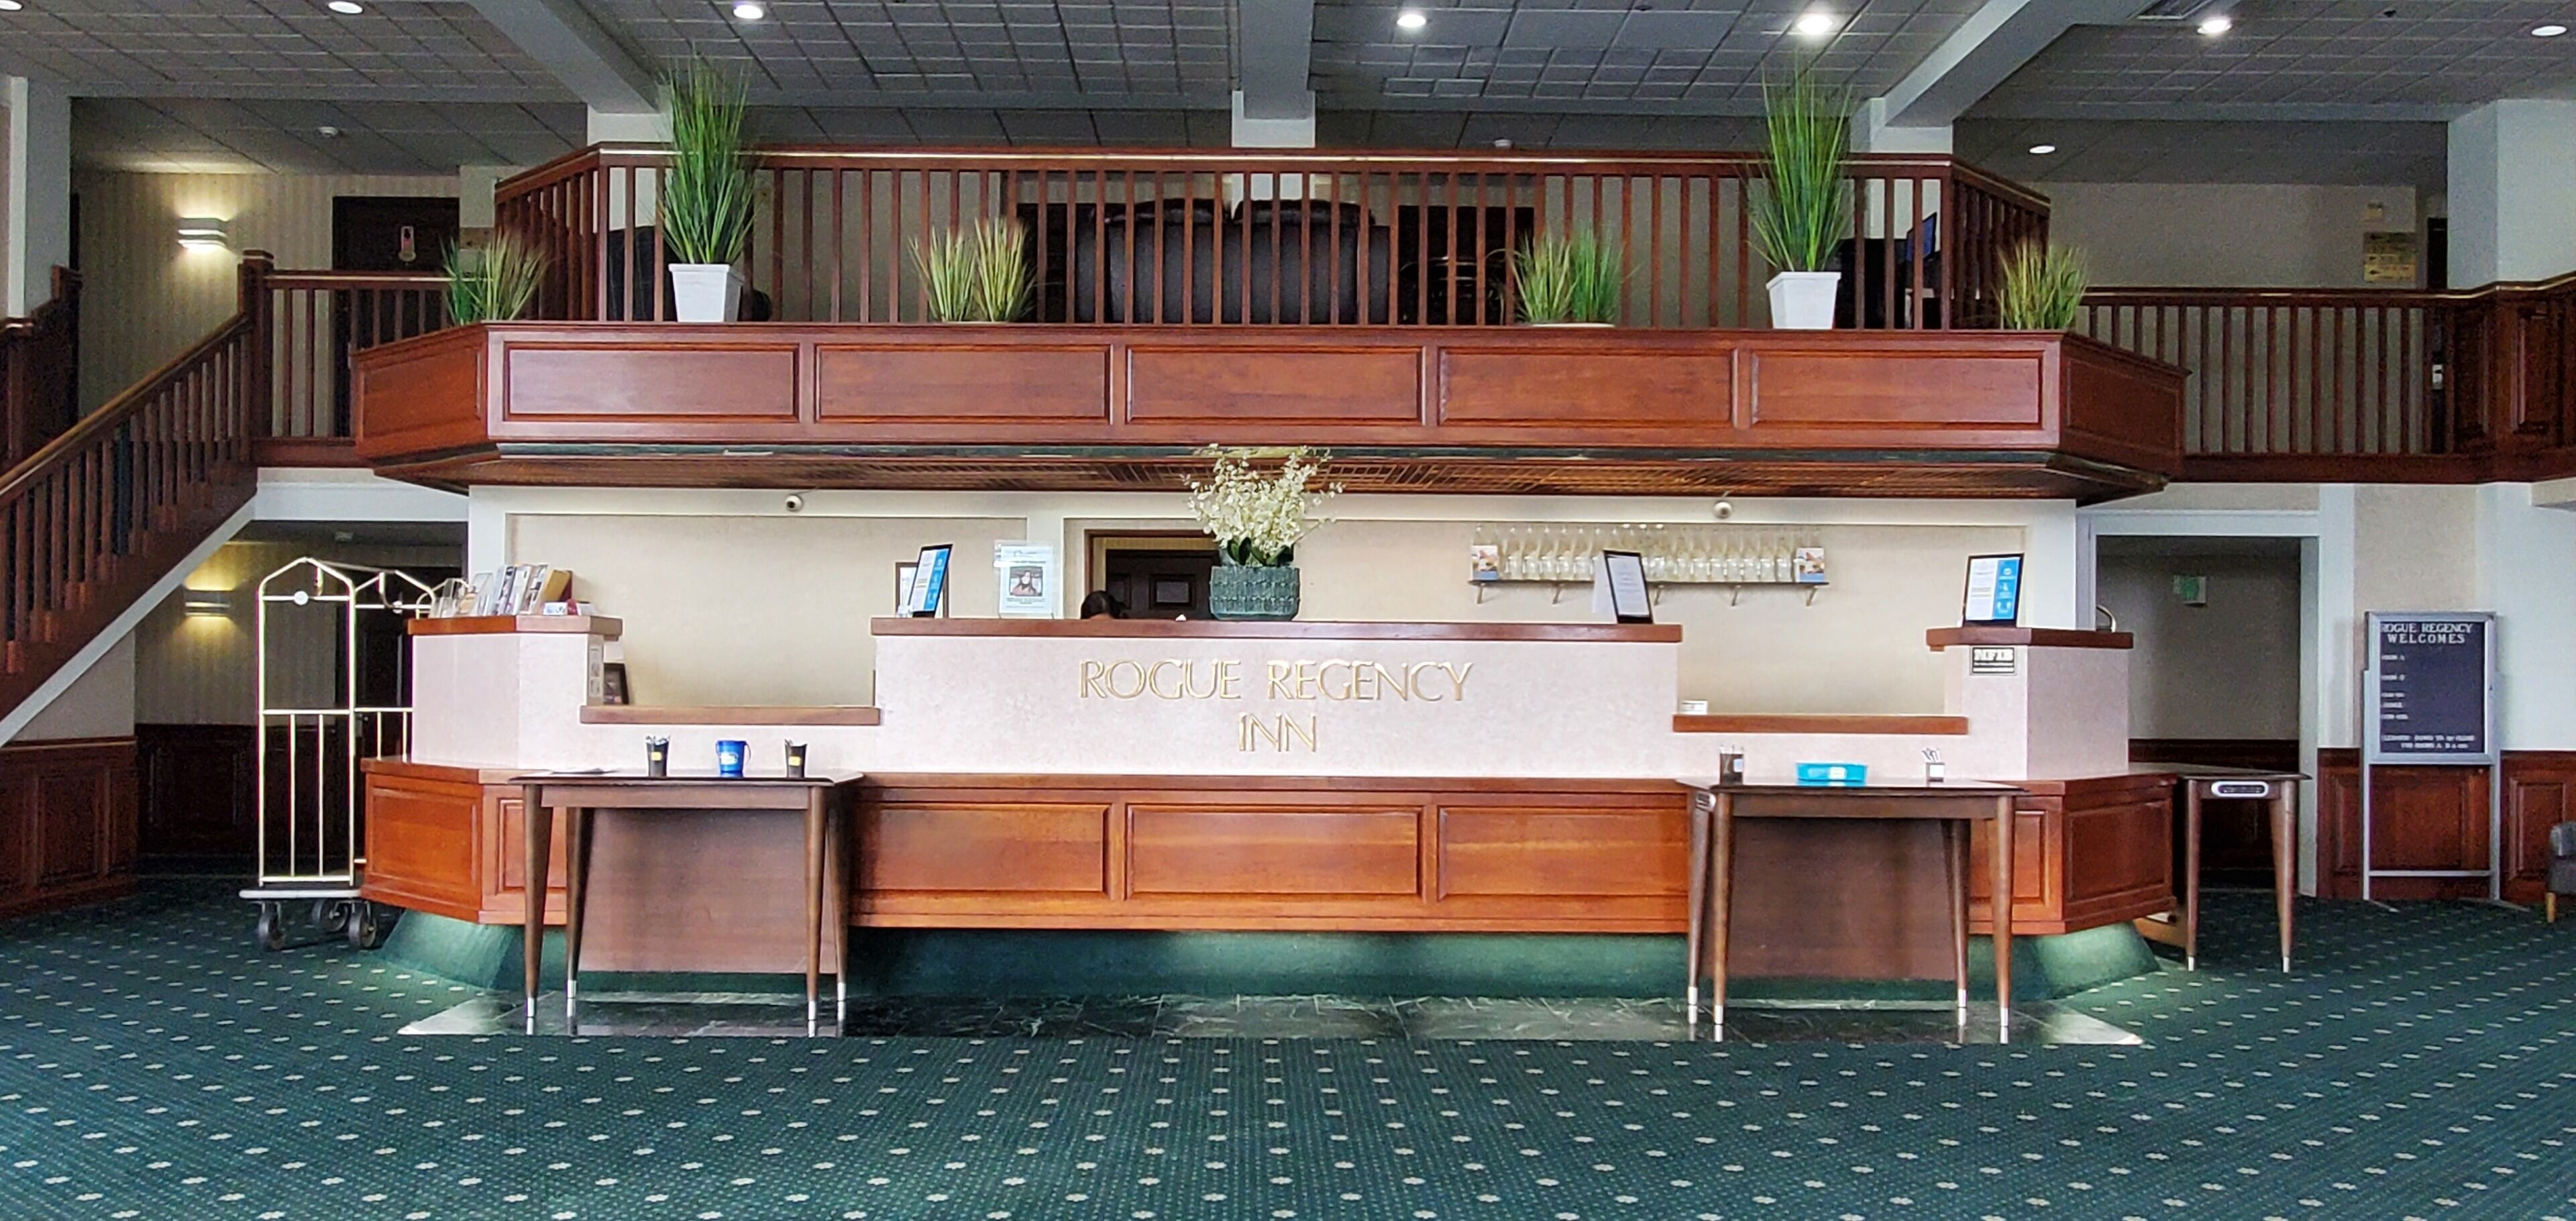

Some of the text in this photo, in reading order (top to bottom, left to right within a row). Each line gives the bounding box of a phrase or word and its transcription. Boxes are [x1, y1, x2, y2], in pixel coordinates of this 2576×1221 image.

[2381, 623, 2473, 633] ROGUE REGENCY
[2387, 633, 2465, 643] WELCOMES
[1079, 659, 1473, 701] ROGUE REGENCY
[1238, 712, 1317, 753] INN
